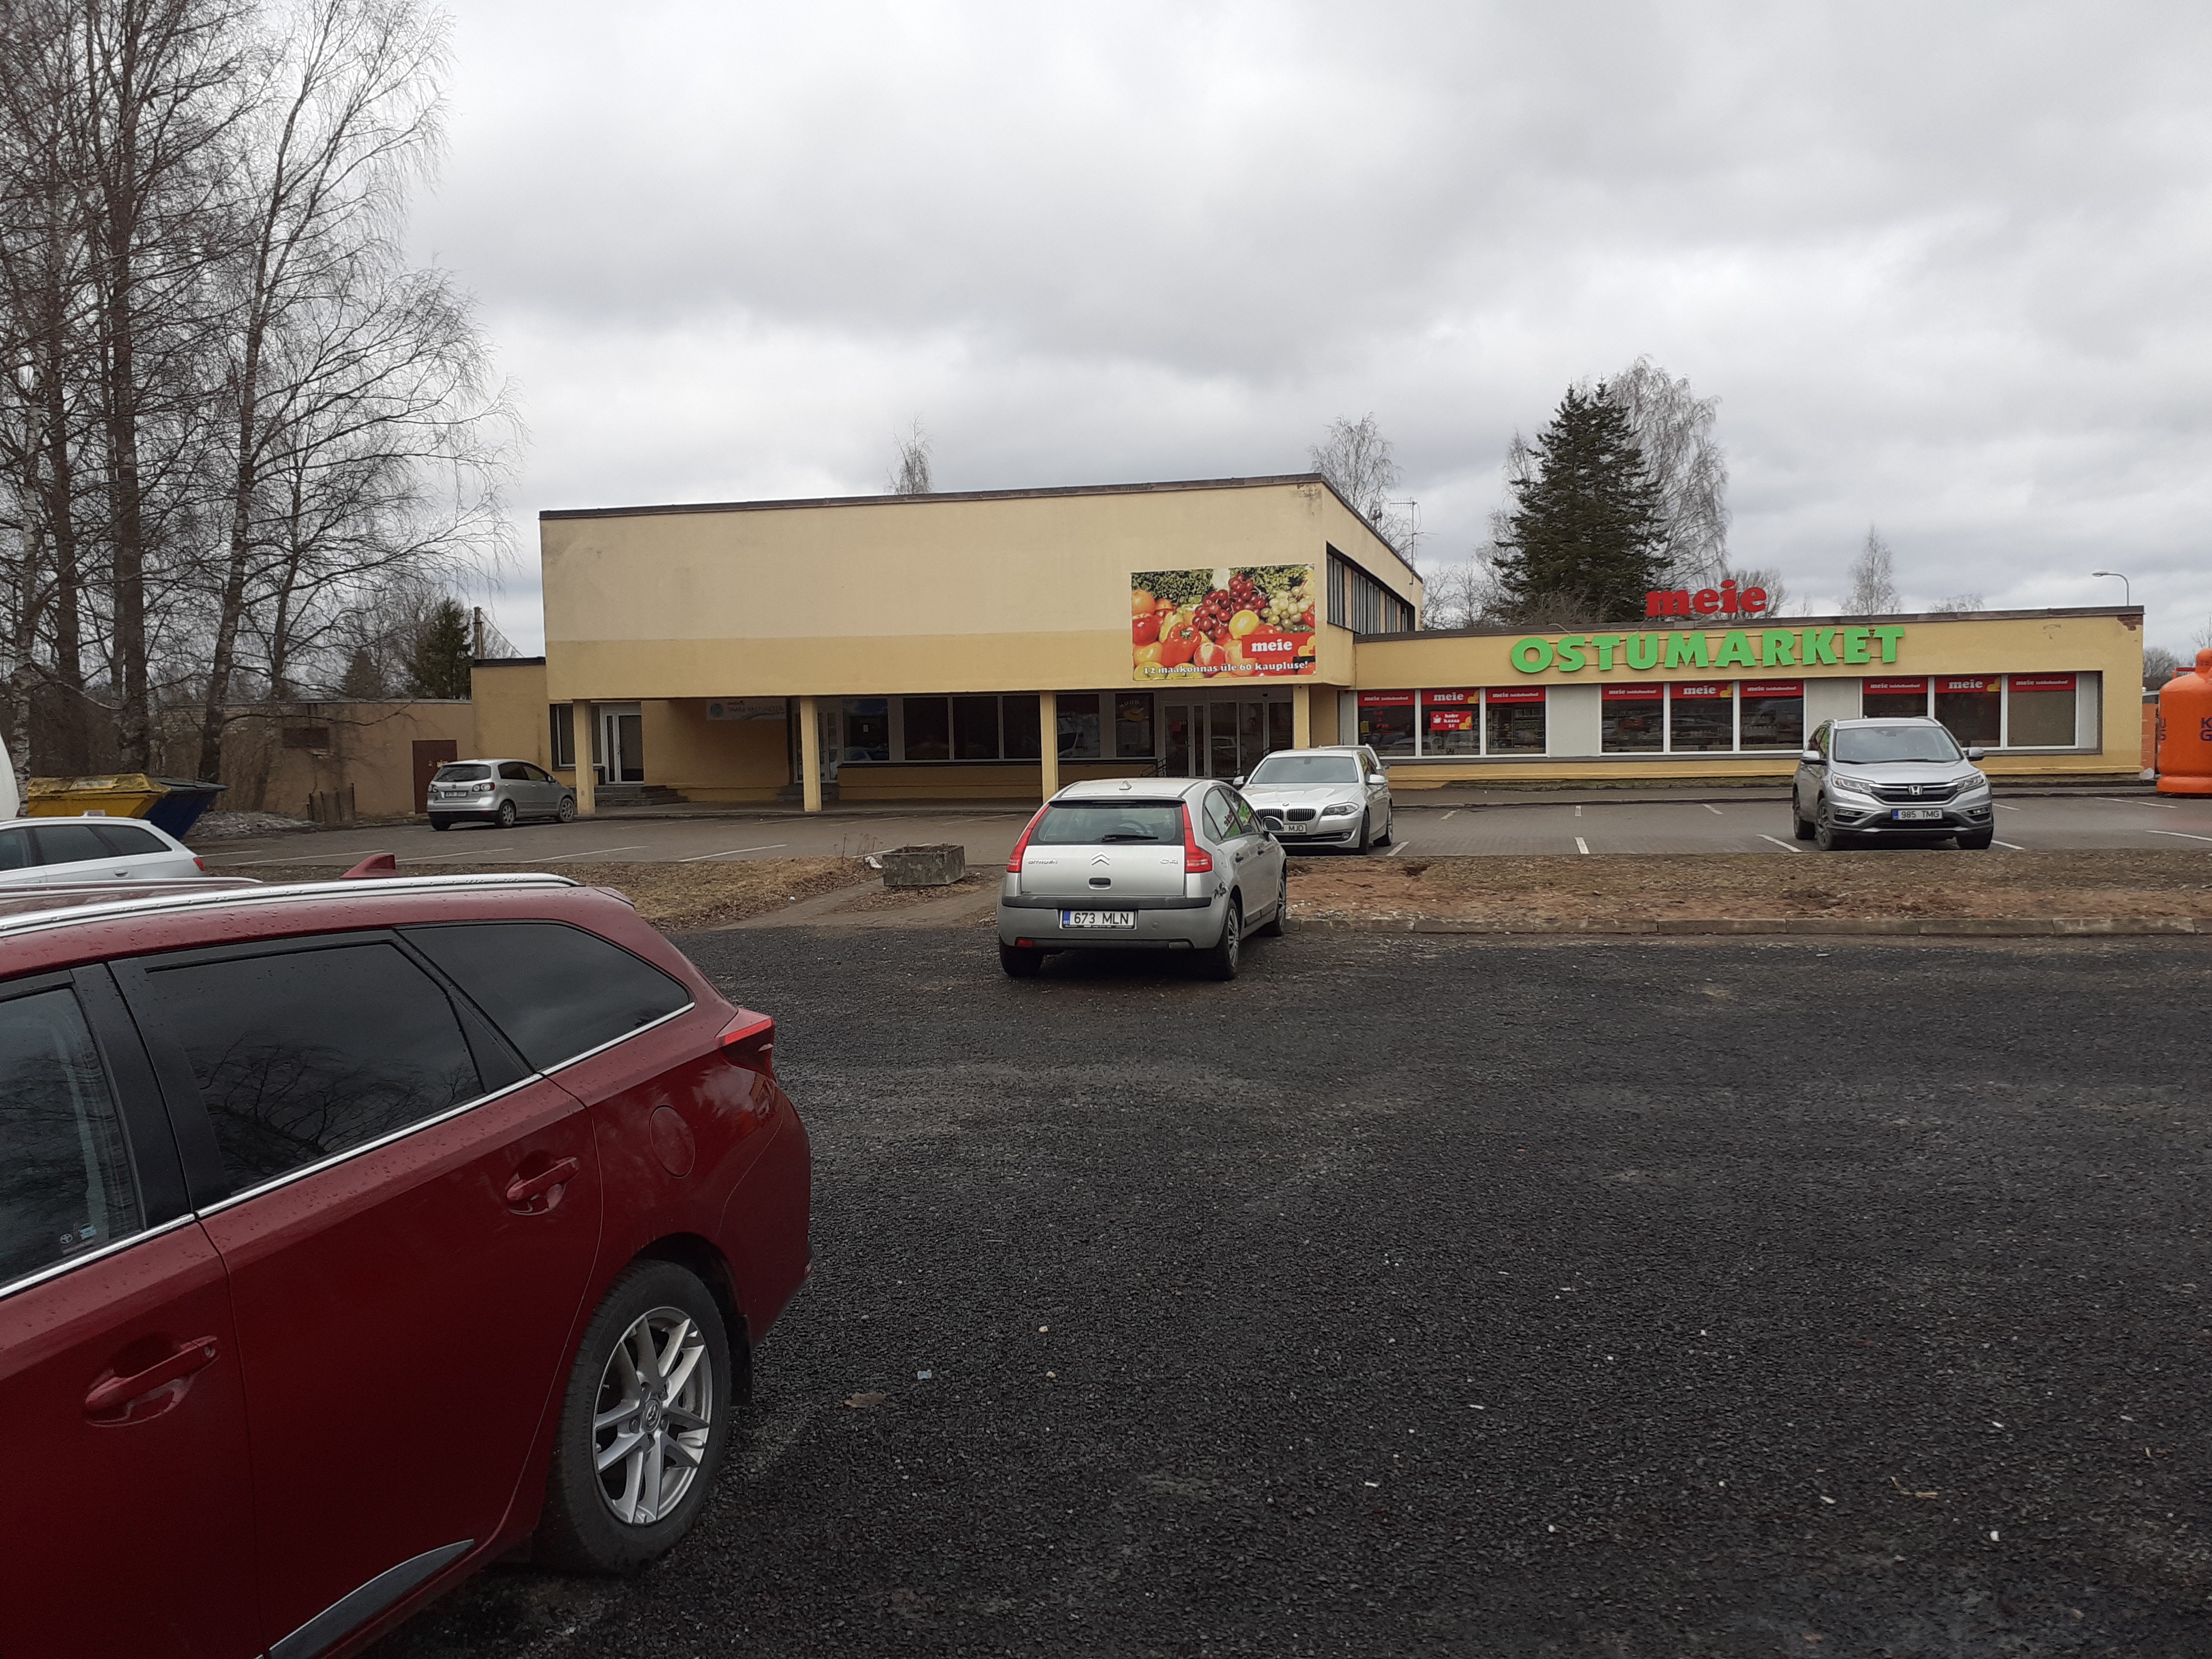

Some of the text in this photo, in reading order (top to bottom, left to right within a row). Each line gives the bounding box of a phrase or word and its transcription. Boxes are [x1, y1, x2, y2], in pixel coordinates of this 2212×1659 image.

[1645, 580, 1767, 616] meie
[1251, 639, 1292, 652] meie
[1511, 626, 1905, 673] OSTUMARKET
[1157, 665, 1218, 674] maakonnas
[1220, 663, 1237, 671] üle
[1255, 661, 1308, 671] kaupluse!
[1948, 679, 1983, 689] meie
[1683, 685, 1716, 695] meie
[1433, 692, 1464, 701] meie
[1921, 810, 1940, 818] TMG
[1074, 913, 1129, 924] 673 MLN
